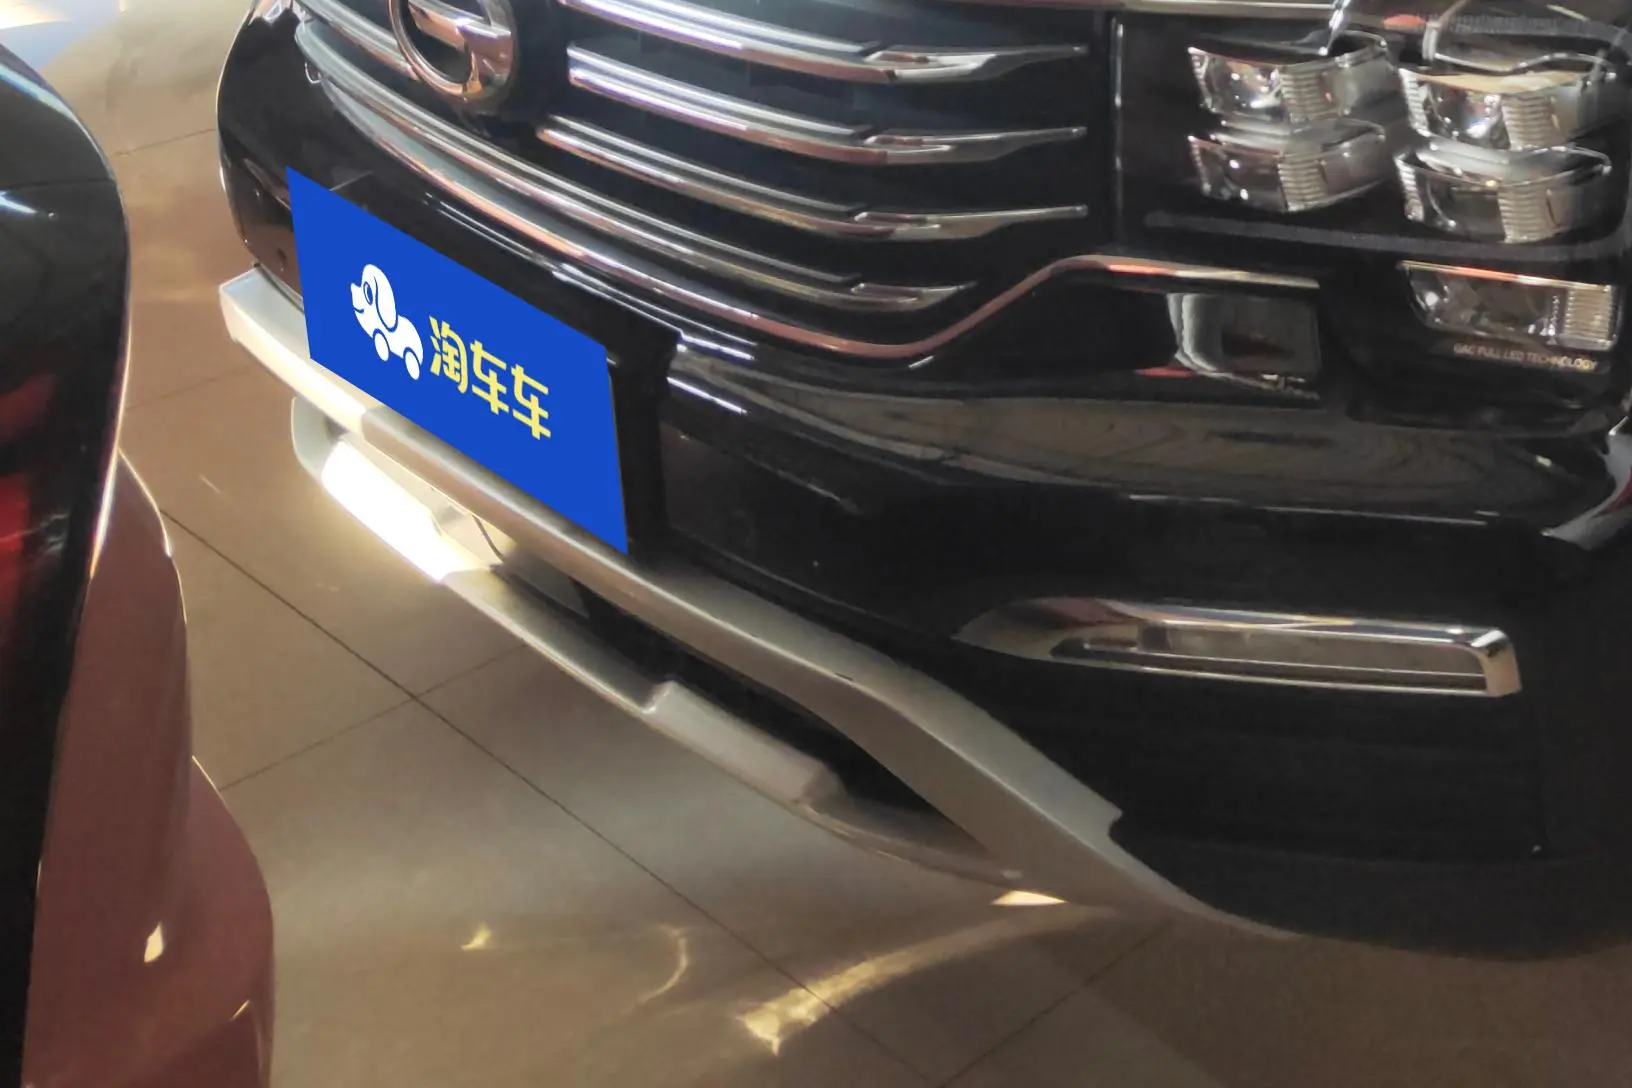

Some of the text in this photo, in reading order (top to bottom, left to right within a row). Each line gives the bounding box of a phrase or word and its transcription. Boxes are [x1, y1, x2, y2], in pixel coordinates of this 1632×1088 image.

[1477, 345, 1500, 358] FULL
[1504, 349, 1525, 362] LED
[1526, 352, 1598, 371] TECHNOLOGY
